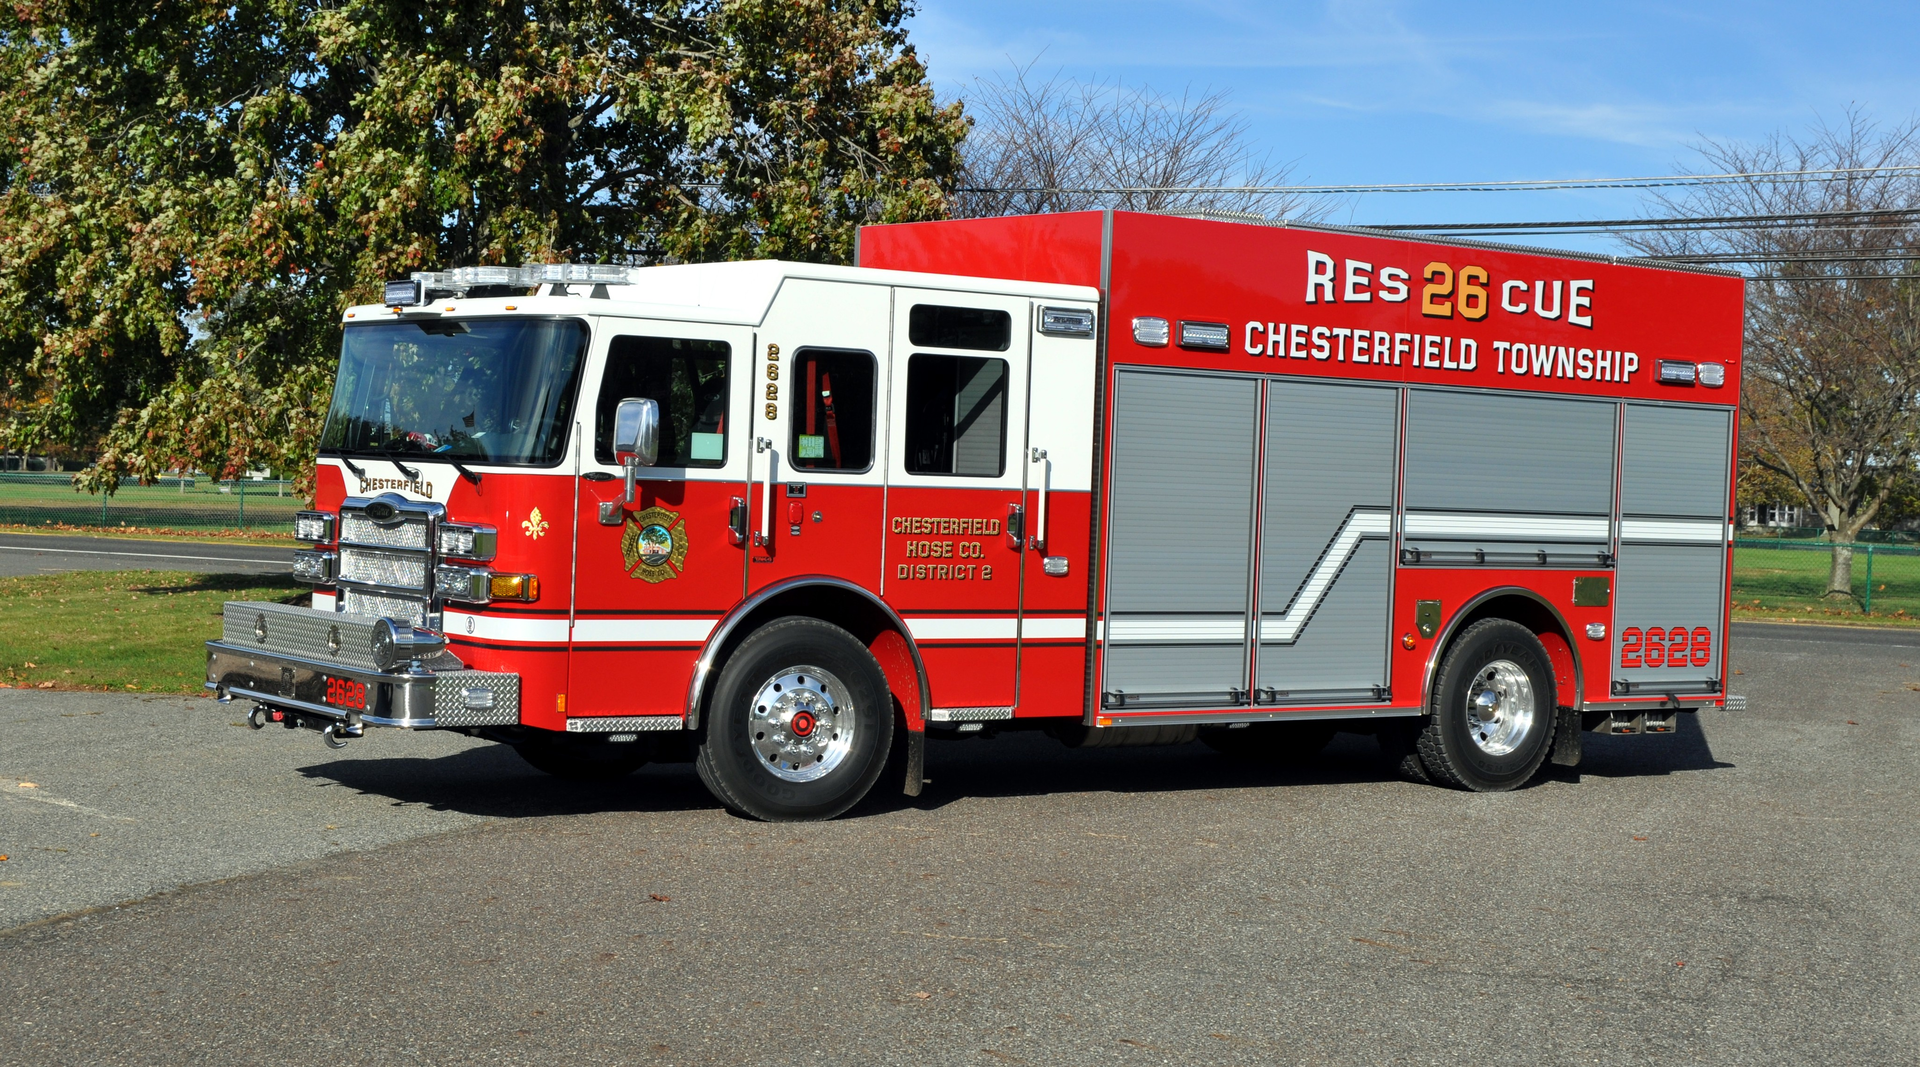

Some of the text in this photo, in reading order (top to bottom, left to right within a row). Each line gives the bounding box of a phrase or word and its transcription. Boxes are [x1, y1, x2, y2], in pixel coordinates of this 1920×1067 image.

[1305, 249, 1594, 330] RES 26 CUE
[1244, 320, 1639, 383] CHESTERFIELD TOWNSHIP
[765, 343, 779, 420] 2628
[360, 477, 433, 499] CHESTERFIELD
[892, 516, 1000, 536] CHESTERFIELD
[906, 540, 985, 559] HOSE CO.
[897, 564, 993, 580] DISTRICT 2
[1620, 626, 1711, 669] 2628
[327, 676, 366, 710] 2628
